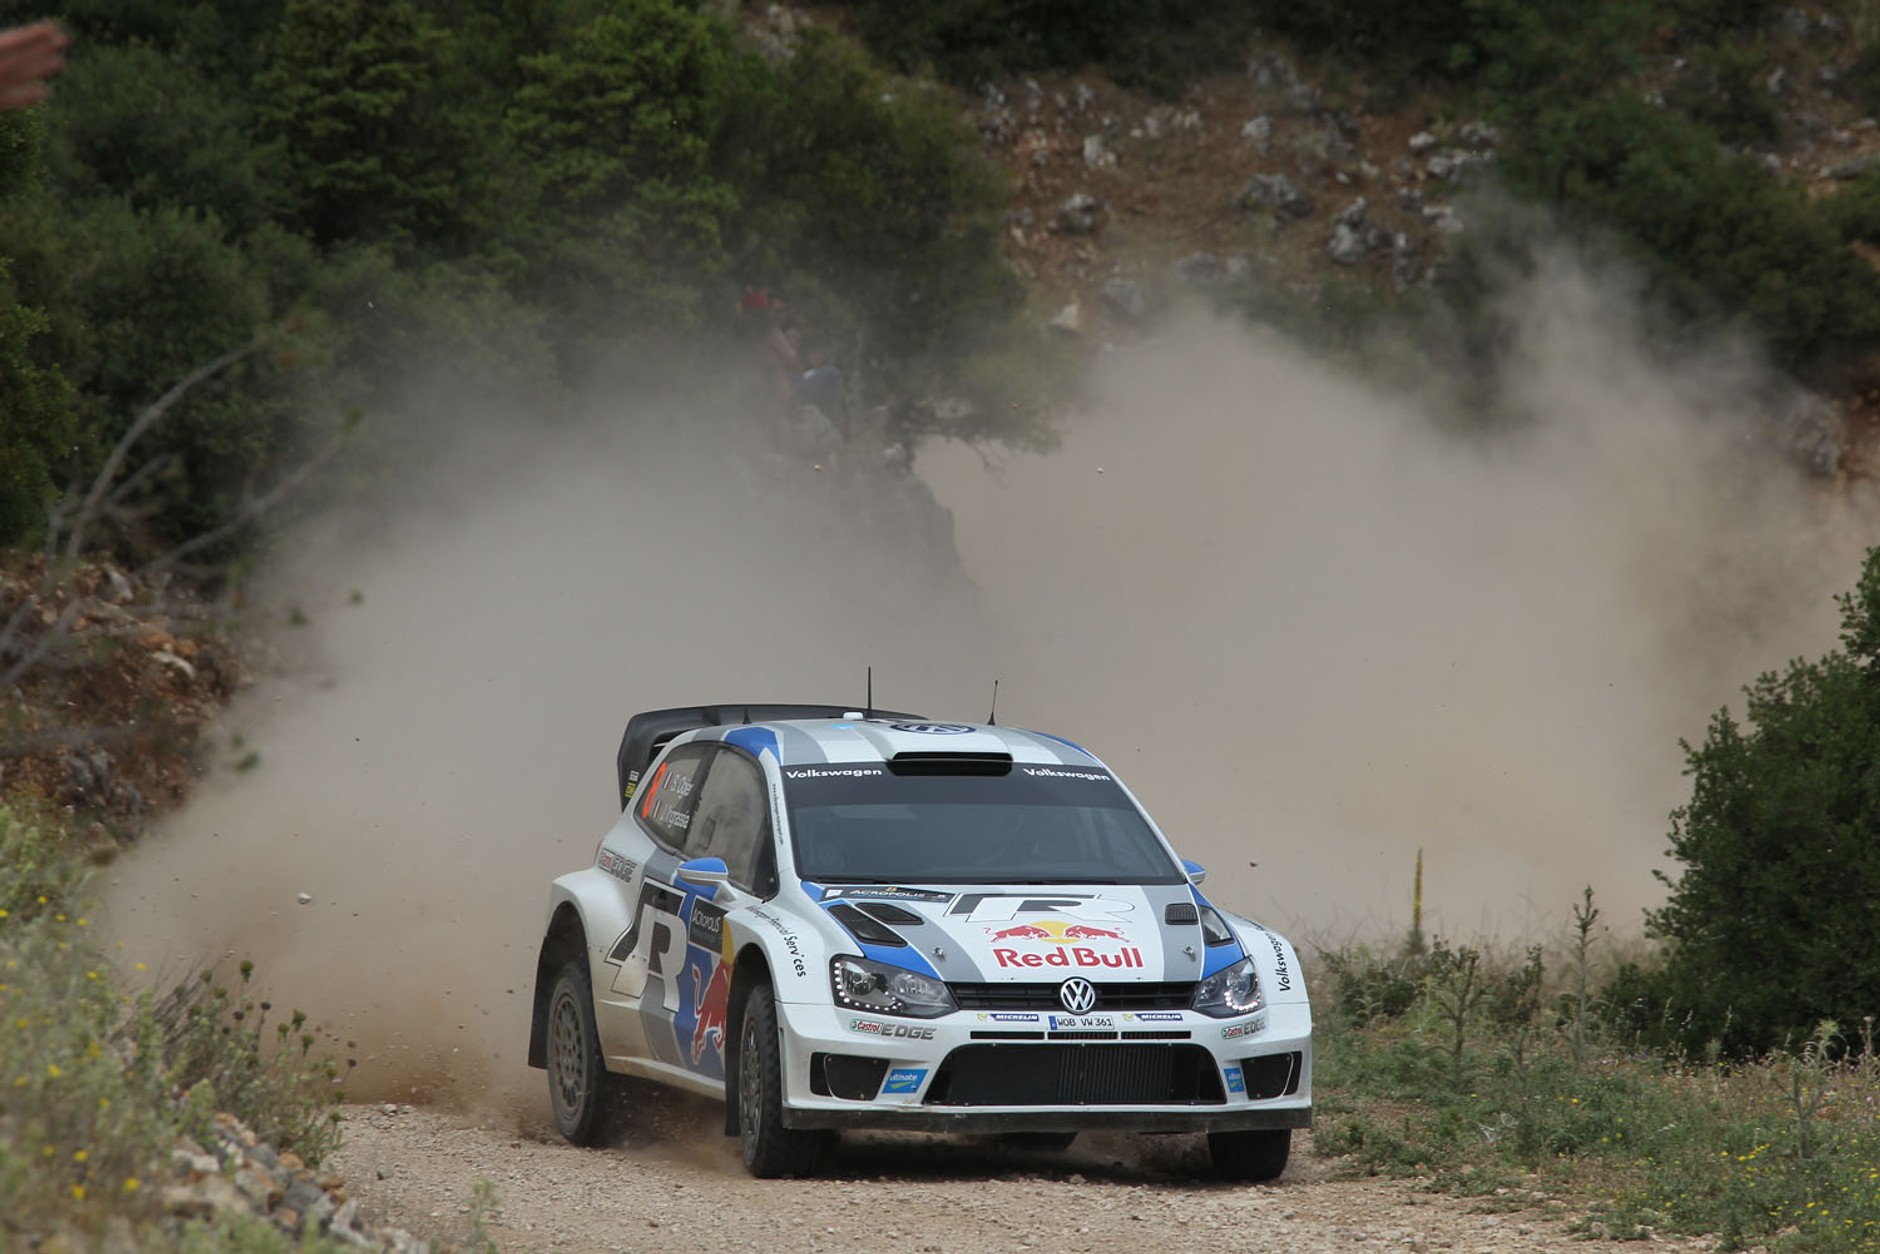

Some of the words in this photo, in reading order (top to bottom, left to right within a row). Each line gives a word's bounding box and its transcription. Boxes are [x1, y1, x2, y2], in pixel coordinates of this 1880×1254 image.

[786, 769, 882, 779] Volkswagen
[1022, 768, 1110, 781] Volkswagen
[849, 889, 926, 897] ACROPOLIS
[783, 935, 807, 977] Servces
[993, 947, 1070, 968] Red
[1071, 947, 1144, 968] Bull
[1060, 978, 1096, 1013] VW
[1057, 1018, 1076, 1027] WOB
[1081, 1018, 1094, 1026] VW
[1095, 1018, 1113, 1026] 361
[881, 1023, 937, 1040] EDGE
